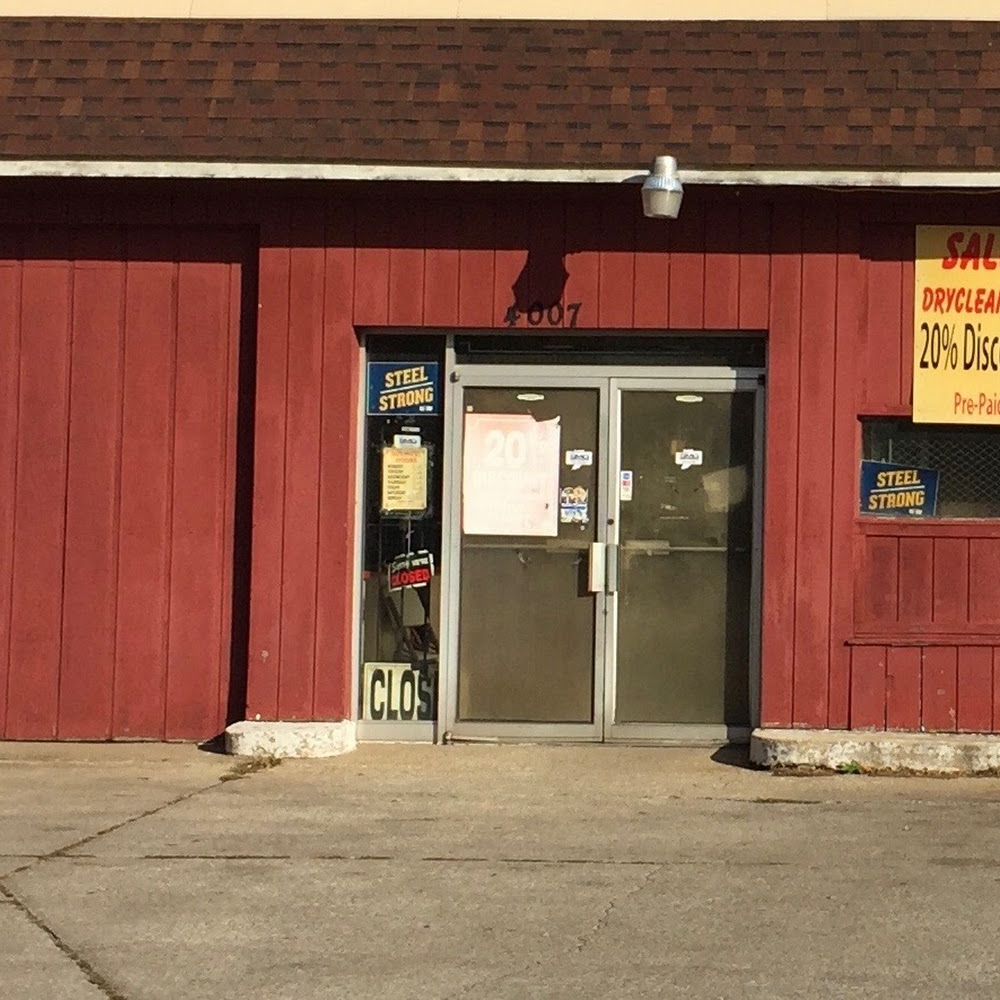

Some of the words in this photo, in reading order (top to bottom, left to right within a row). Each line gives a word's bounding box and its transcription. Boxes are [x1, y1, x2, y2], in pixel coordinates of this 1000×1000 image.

[919, 322, 958, 370] 20%
[385, 366, 428, 388] STEEL
[379, 387, 434, 411] STRONG
[877, 470, 921, 488] STEEL
[868, 490, 925, 510] STRONG
[391, 569, 430, 586] CLOSED
